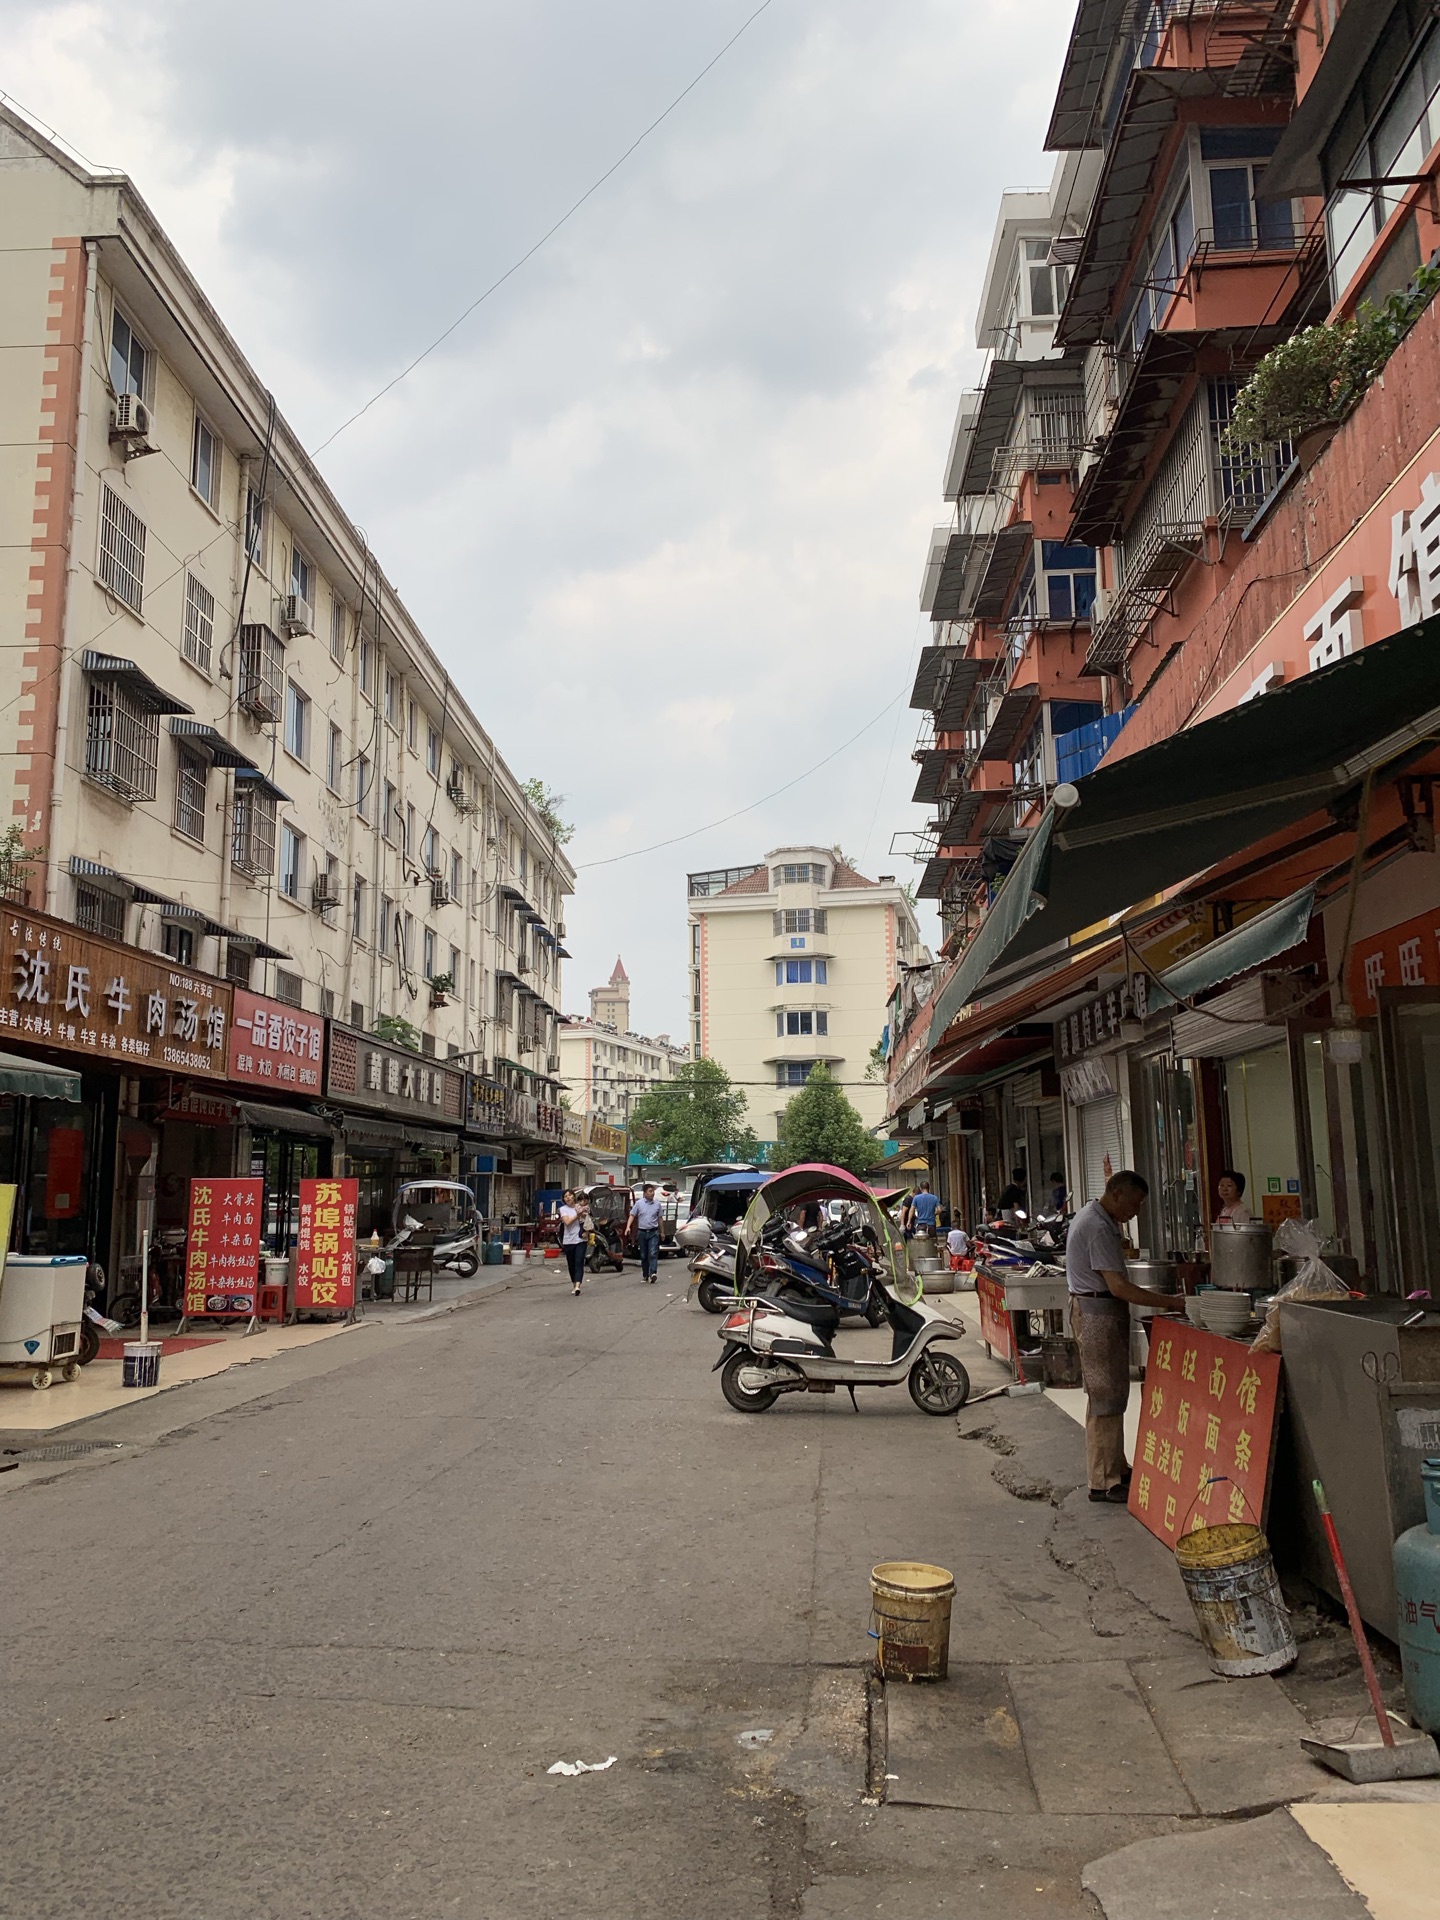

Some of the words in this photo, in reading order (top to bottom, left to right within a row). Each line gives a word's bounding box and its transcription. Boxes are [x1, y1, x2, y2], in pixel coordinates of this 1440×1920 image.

[9, 920, 62, 951] 古法传统
[13, 949, 225, 1051] 沈氏牛肉汤馆
[193, 982, 213, 999] 六安店
[236, 1009, 321, 1061] 一品香饺子馆
[163, 1046, 211, 1070] 13865438052
[222, 1192, 255, 1207] 大骨头
[221, 1212, 254, 1226] 牛肉面
[299, 1203, 312, 1251] 鲜肉馄饨
[342, 1203, 355, 1239] 锅贴饺
[187, 1186, 213, 1312] 沈氏牛肉汤馆
[219, 1233, 253, 1248] 牛杂面
[311, 1183, 342, 1304] 苏埠锅贴饺
[208, 1254, 256, 1268] 牛肉粉丝汤
[297, 1263, 309, 1287] 水饺
[340, 1251, 353, 1287] 水煎包
[207, 1275, 255, 1290] 牛杂粉丝汤
[1156, 1340, 1262, 1415] 旺旺面馆
[1142, 1429, 1184, 1485] 盖浇饭
